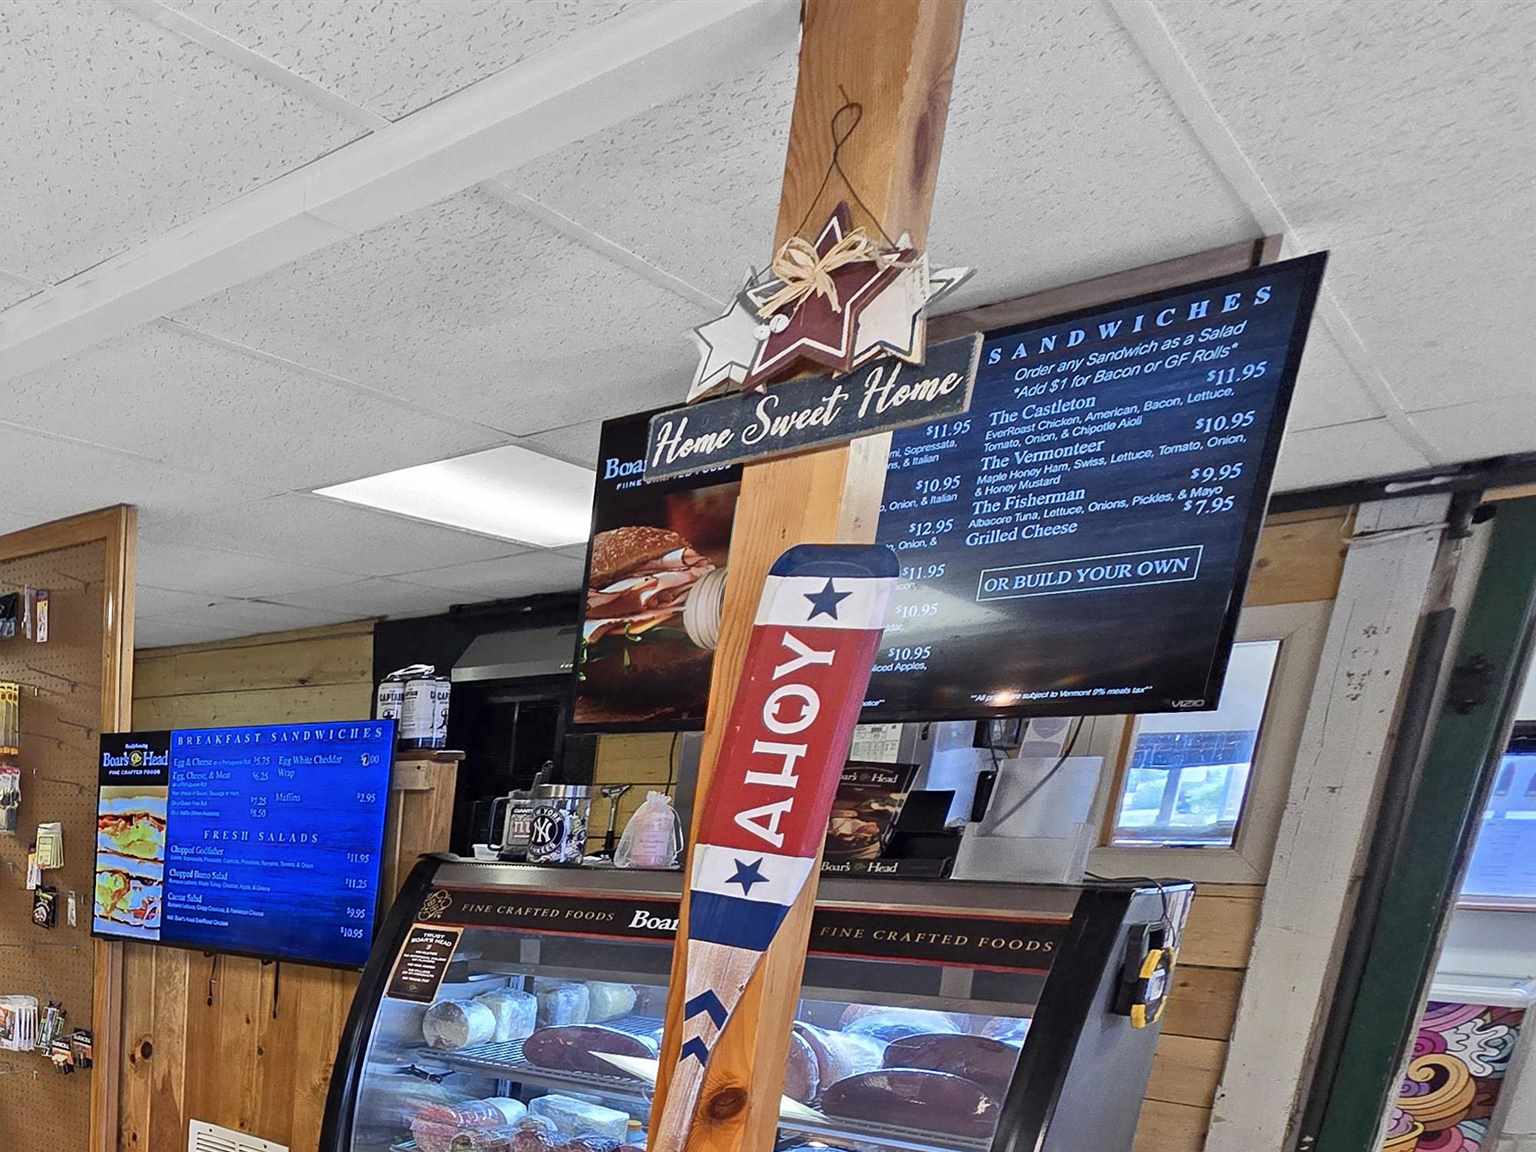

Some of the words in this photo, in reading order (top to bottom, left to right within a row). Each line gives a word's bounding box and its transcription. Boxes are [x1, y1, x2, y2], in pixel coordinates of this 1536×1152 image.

[987, 286, 1272, 365] SANDWICHES
[1014, 362, 1055, 381] Order
[1059, 356, 1085, 373] any
[1087, 339, 1158, 365] Sandwich
[1160, 335, 1181, 349] as
[1184, 333, 1194, 345] a
[1198, 320, 1247, 343] Salad
[1049, 378, 1068, 393] $1
[1071, 374, 1091, 388] for
[1093, 364, 1141, 384] Bacon
[1144, 361, 1162, 373] or
[1164, 351, 1190, 369] GF
[1207, 361, 1267, 387] $11.95
[651, 416, 735, 468] Home
[741, 384, 849, 446] Sweet
[858, 362, 965, 419] Home
[986, 420, 1036, 441] EverRoast
[1038, 415, 1083, 431] Chicken,
[1084, 404, 1141, 423] American,
[1143, 395, 1184, 412] Bacon,
[989, 407, 1018, 426] The
[1022, 394, 1097, 420] Castleton
[926, 419, 971, 439] $11.95
[1024, 431, 1061, 446] Onion,
[1061, 429, 1070, 439] &
[1072, 421, 1117, 437] Chipotle
[1119, 415, 1143, 428] Aioli
[1195, 410, 1257, 434] $10.95
[912, 454, 940, 466] Italian
[981, 452, 1010, 472] The
[1013, 439, 1106, 465] Vermonteer
[977, 469, 1009, 486] Maple
[1010, 463, 1042, 480] Honey
[1044, 458, 1071, 474] Ham,
[1074, 451, 1108, 470] Swiss,
[1190, 461, 1244, 482] $9.95
[916, 475, 961, 494] $10.95
[975, 486, 983, 497] &
[984, 480, 1018, 497] Honey
[1019, 474, 1061, 491] Mustard
[930, 494, 958, 505] Italian
[968, 514, 1013, 530] Albacore
[1015, 508, 1041, 523] Tuna,
[1088, 497, 1129, 512] Onions,
[1132, 491, 1174, 507] Pickles,
[1178, 489, 1187, 500] &
[1190, 484, 1224, 500] Mayo
[972, 499, 1001, 515] The
[1004, 486, 1087, 509] Fisherman
[1183, 496, 1236, 516] $7.95
[909, 519, 954, 537] $12.95
[965, 522, 1018, 548] Grilled
[1020, 521, 1079, 542] Cheese
[902, 563, 946, 580] $11.95
[984, 578, 1009, 593] OR
[1013, 570, 1072, 590] BUILD
[1077, 564, 1132, 584] YOUR
[1137, 557, 1190, 576] OWN
[896, 603, 938, 618] $10.95
[888, 646, 932, 660] $10.95
[1060, 689, 1091, 698] Vermont
[178, 733, 261, 745] BREAKFAST
[271, 728, 382, 742] SANDWICHES
[734, 631, 836, 849] AHOY
[103, 752, 129, 767] Boar's
[143, 750, 168, 766] Head
[871, 773, 898, 783] Head
[204, 830, 249, 841] FRESH
[259, 831, 319, 844] SALADS
[867, 862, 898, 873] Head
[462, 903, 492, 913] FINE
[496, 905, 560, 918] CRAFTED
[564, 908, 615, 921] FOODS
[819, 926, 864, 938] FINE
[873, 929, 969, 946] CRAFTED
[978, 937, 1055, 953] FOODS
